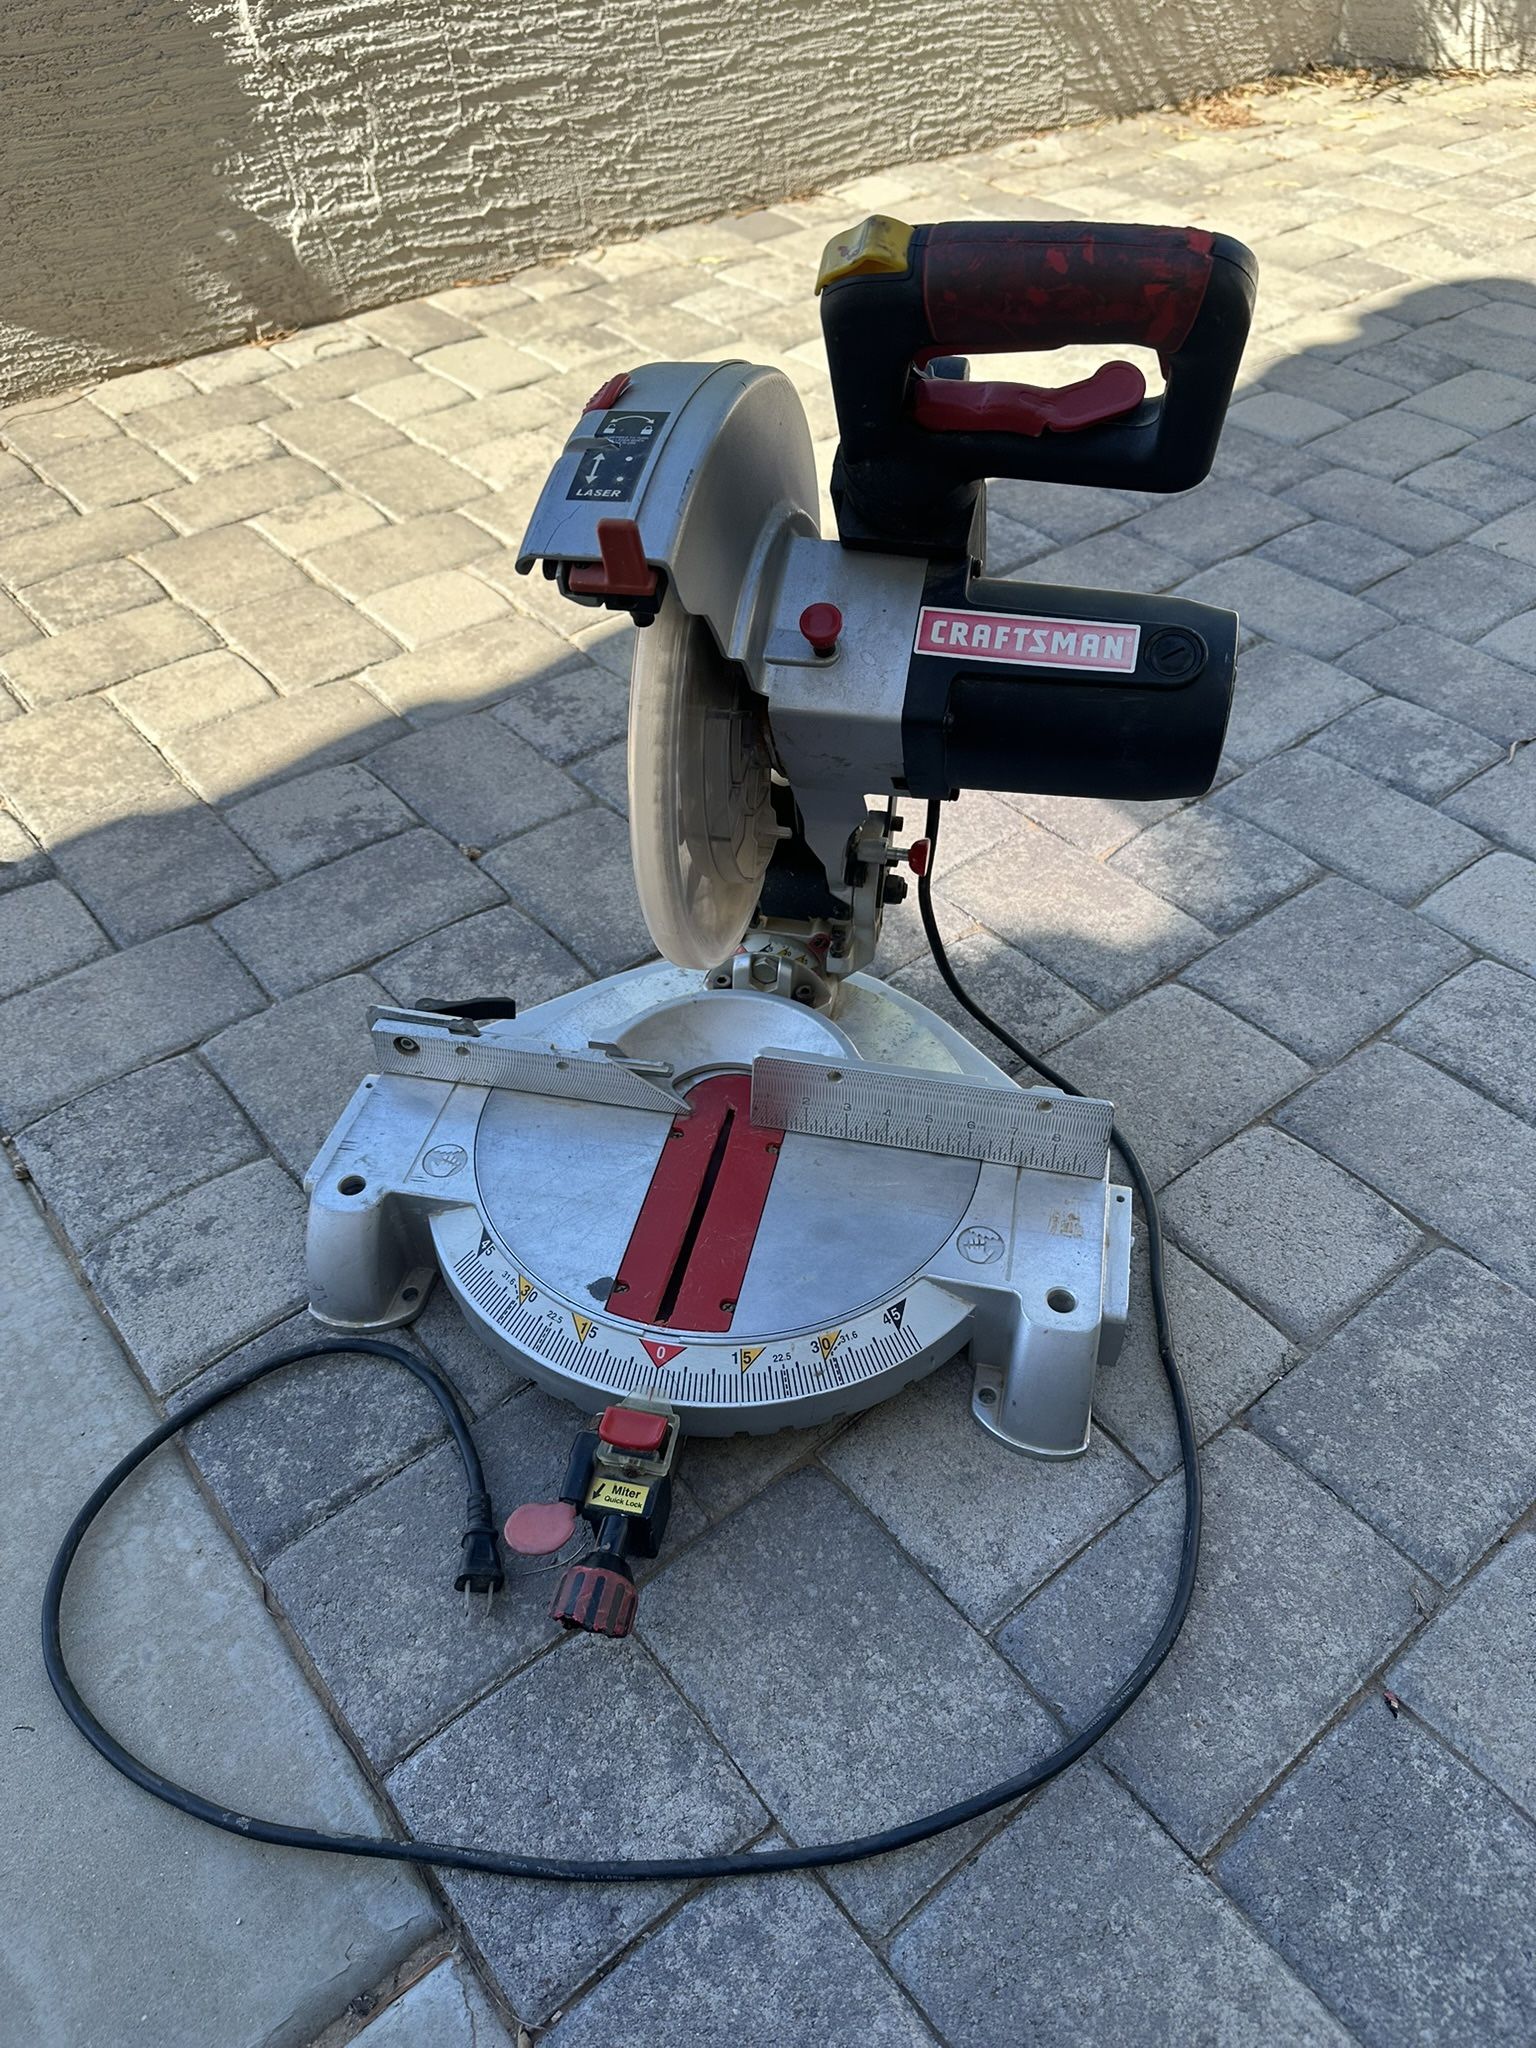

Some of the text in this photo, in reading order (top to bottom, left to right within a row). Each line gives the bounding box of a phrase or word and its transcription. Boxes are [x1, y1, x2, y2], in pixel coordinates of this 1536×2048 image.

[576, 488, 622, 497] LASER
[930, 620, 1125, 660] CRAFTSMAN
[802, 1097, 1061, 1142] 2 3 4 5 6 7 8
[481, 1238, 901, 1365] 45 31.6 30 22.5 15 0 15 22.5 30 31.6 45
[604, 1495, 643, 1508] Quick Lock
[611, 1485, 641, 1498] Miter
